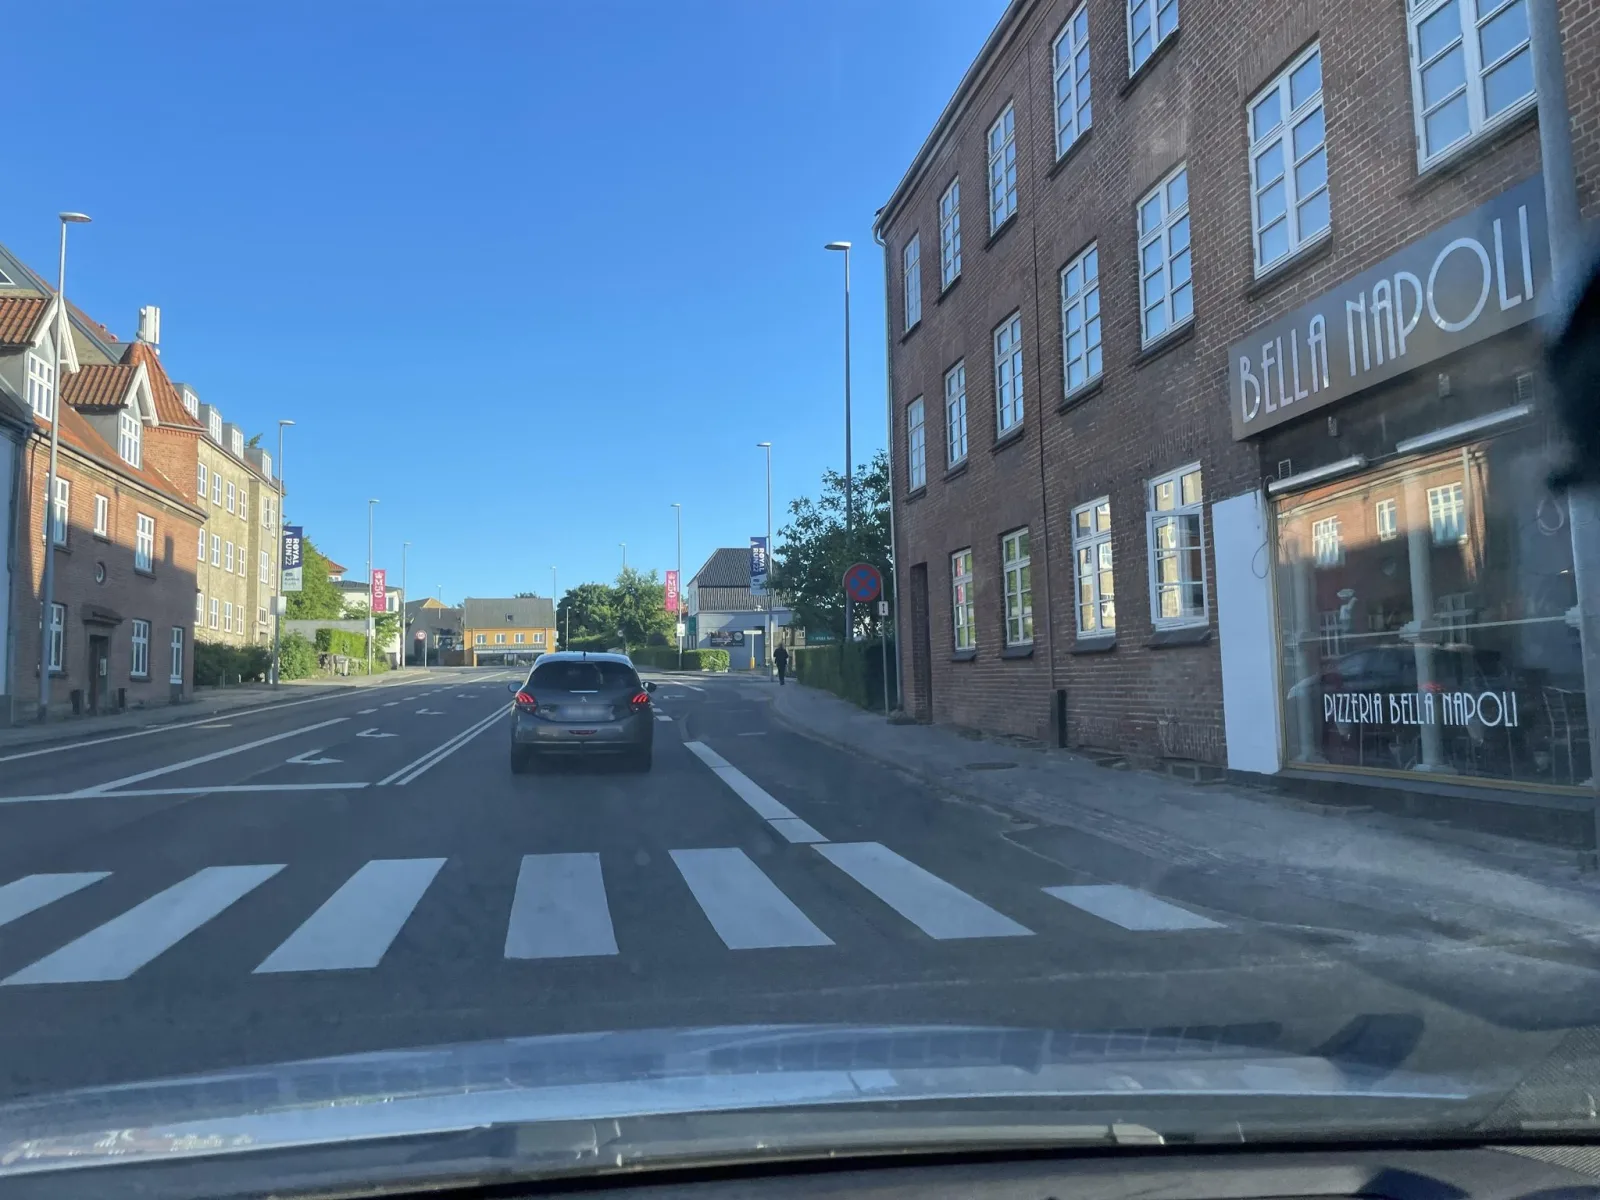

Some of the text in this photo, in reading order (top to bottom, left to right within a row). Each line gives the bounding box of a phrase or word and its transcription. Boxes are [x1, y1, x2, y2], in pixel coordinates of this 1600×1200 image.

[1239, 204, 1535, 423] BELLA NAPOLI
[1324, 691, 1518, 727] PIZZERIA BELLA NAPOLI
